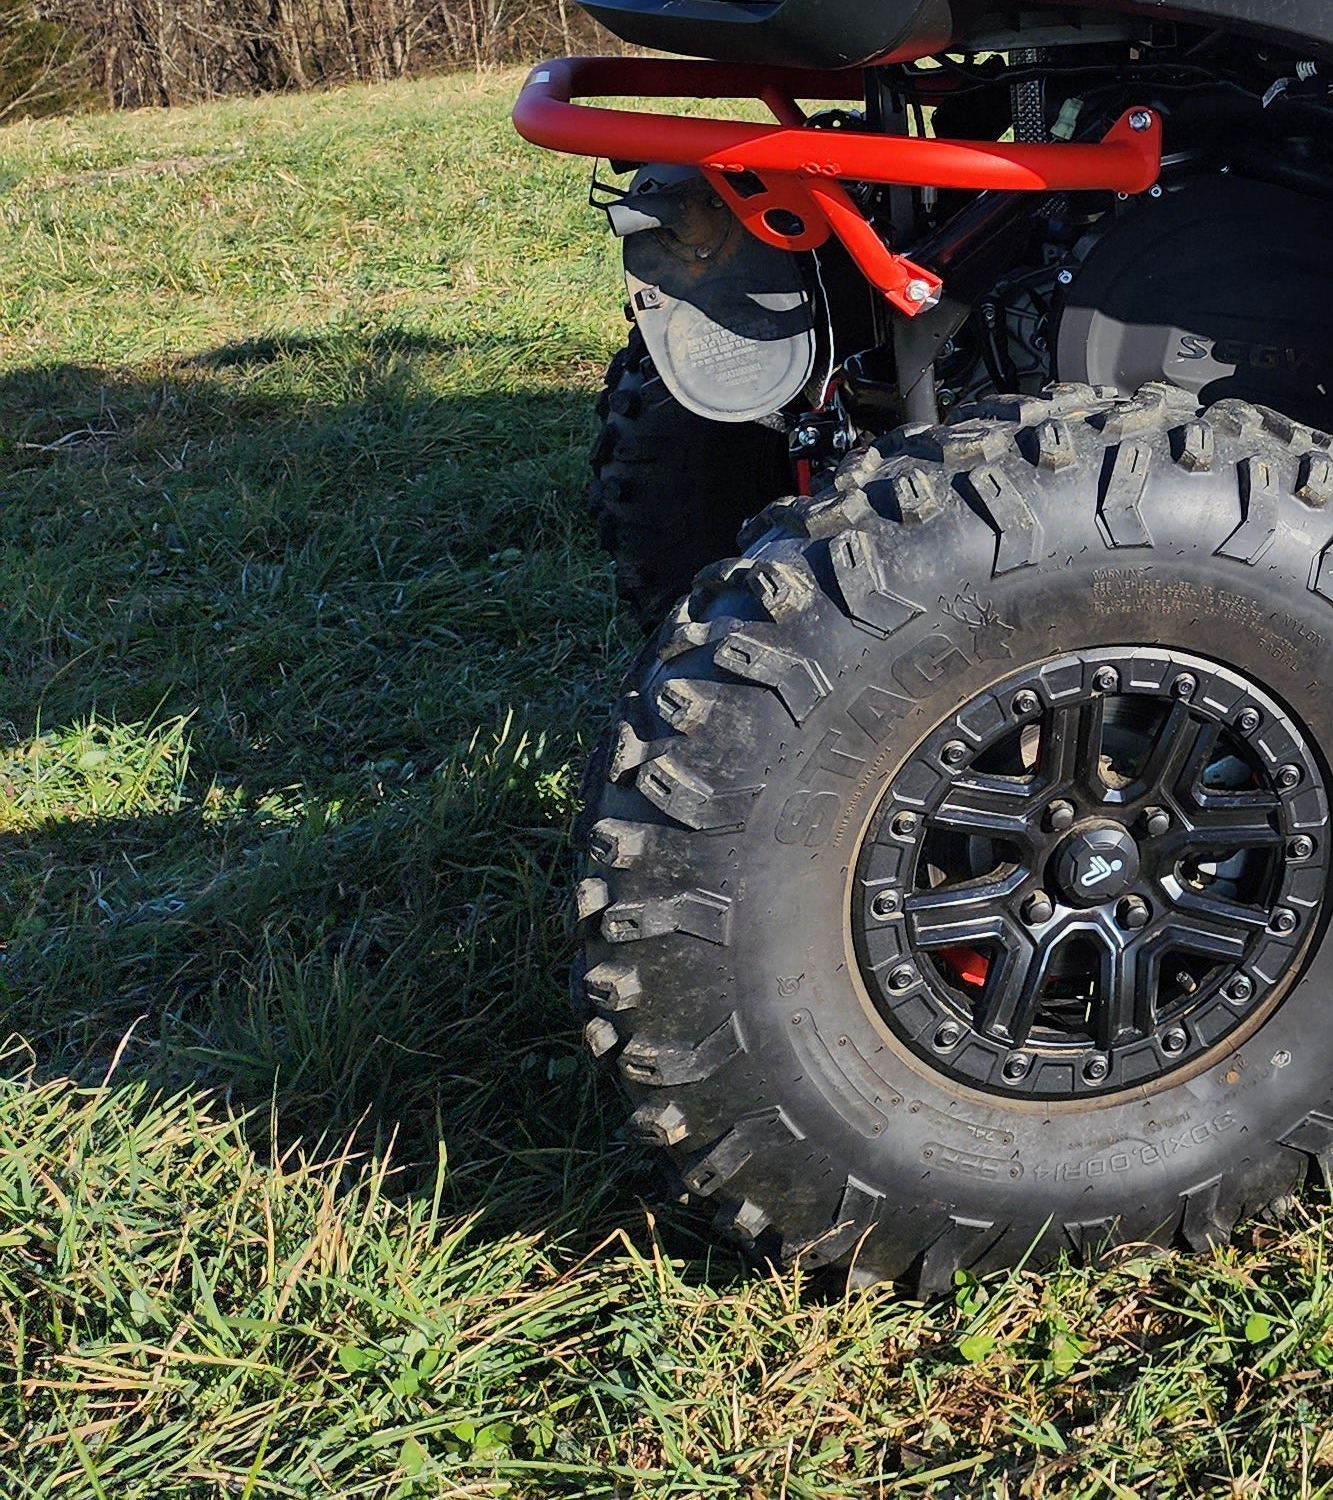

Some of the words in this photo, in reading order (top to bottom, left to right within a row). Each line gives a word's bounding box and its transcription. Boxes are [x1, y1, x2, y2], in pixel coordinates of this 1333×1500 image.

[1282, 612, 1327, 648] NYLON
[1256, 636, 1300, 673] RADIAL
[774, 633, 973, 849] STAG
